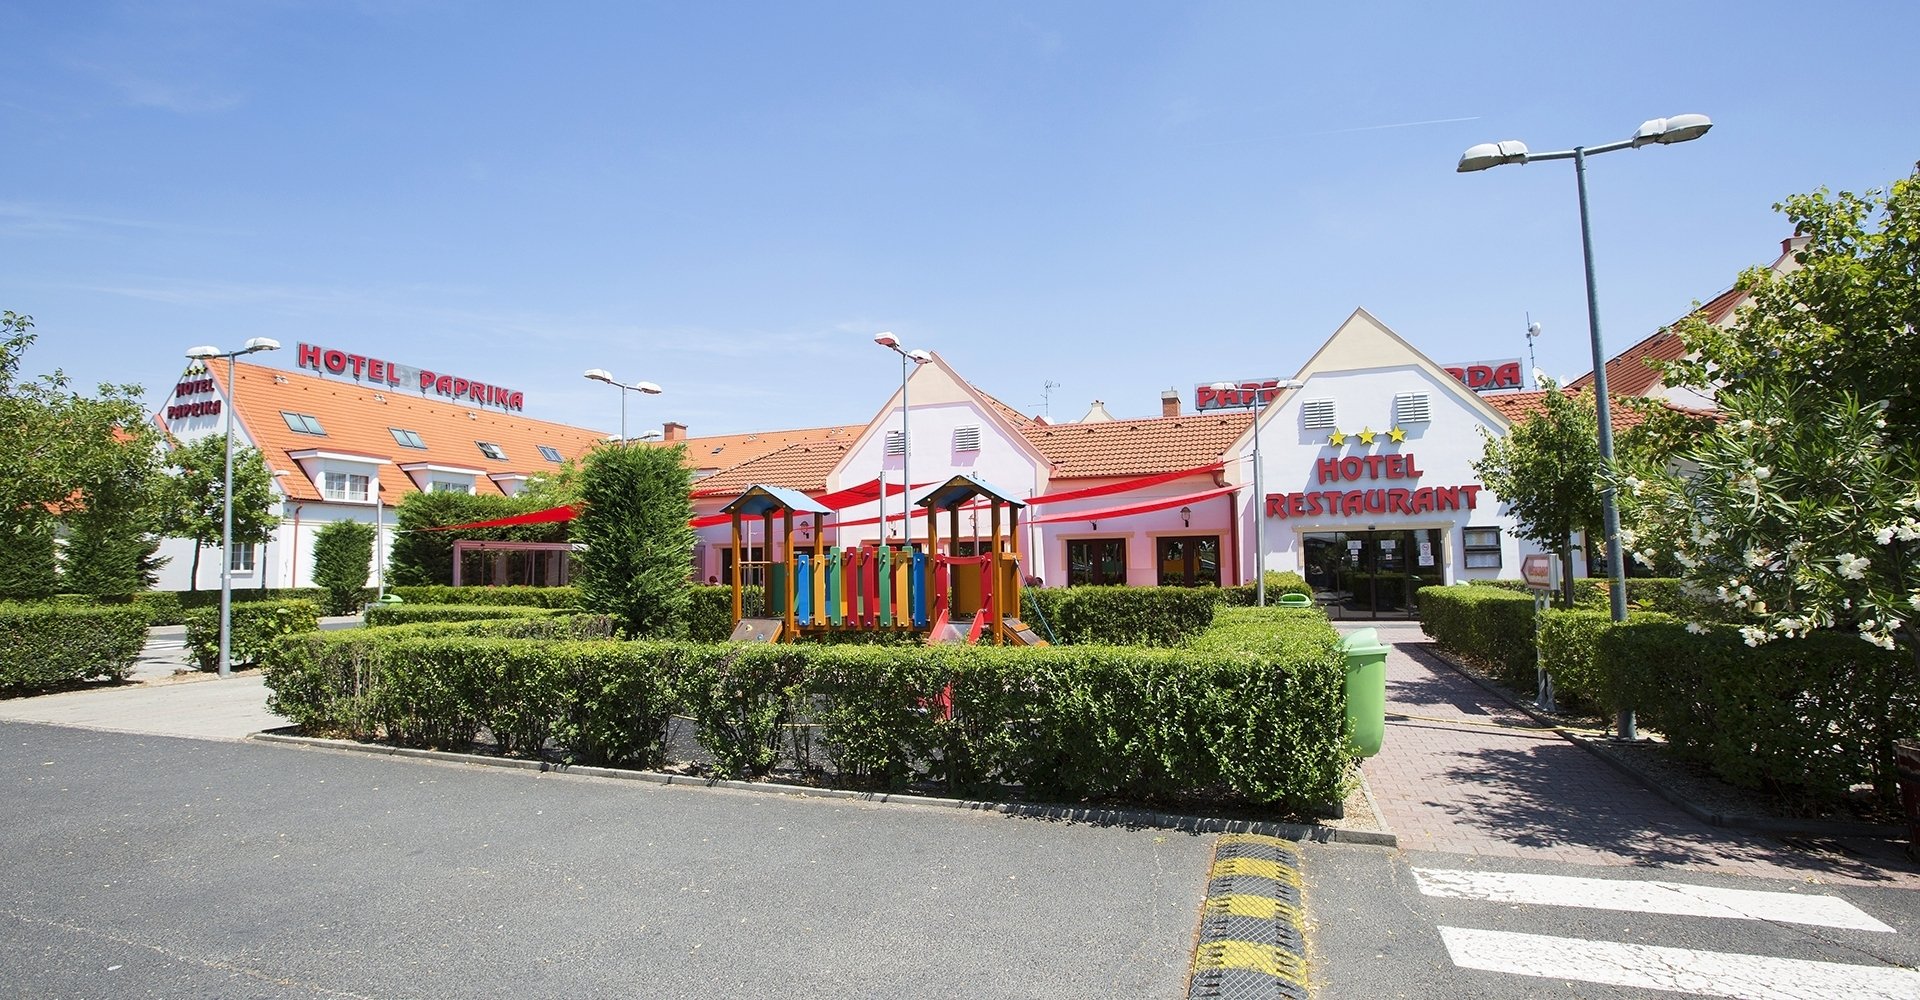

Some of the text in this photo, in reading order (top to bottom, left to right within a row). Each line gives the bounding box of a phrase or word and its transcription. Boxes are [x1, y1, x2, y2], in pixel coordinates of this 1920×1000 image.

[176, 378, 215, 398] HOTEL
[299, 343, 524, 411] HOTEL PAPRIKA
[167, 400, 221, 420] PAPRIKA
[1317, 453, 1424, 485] HOTEL
[1265, 484, 1482, 520] RESTAURANT
